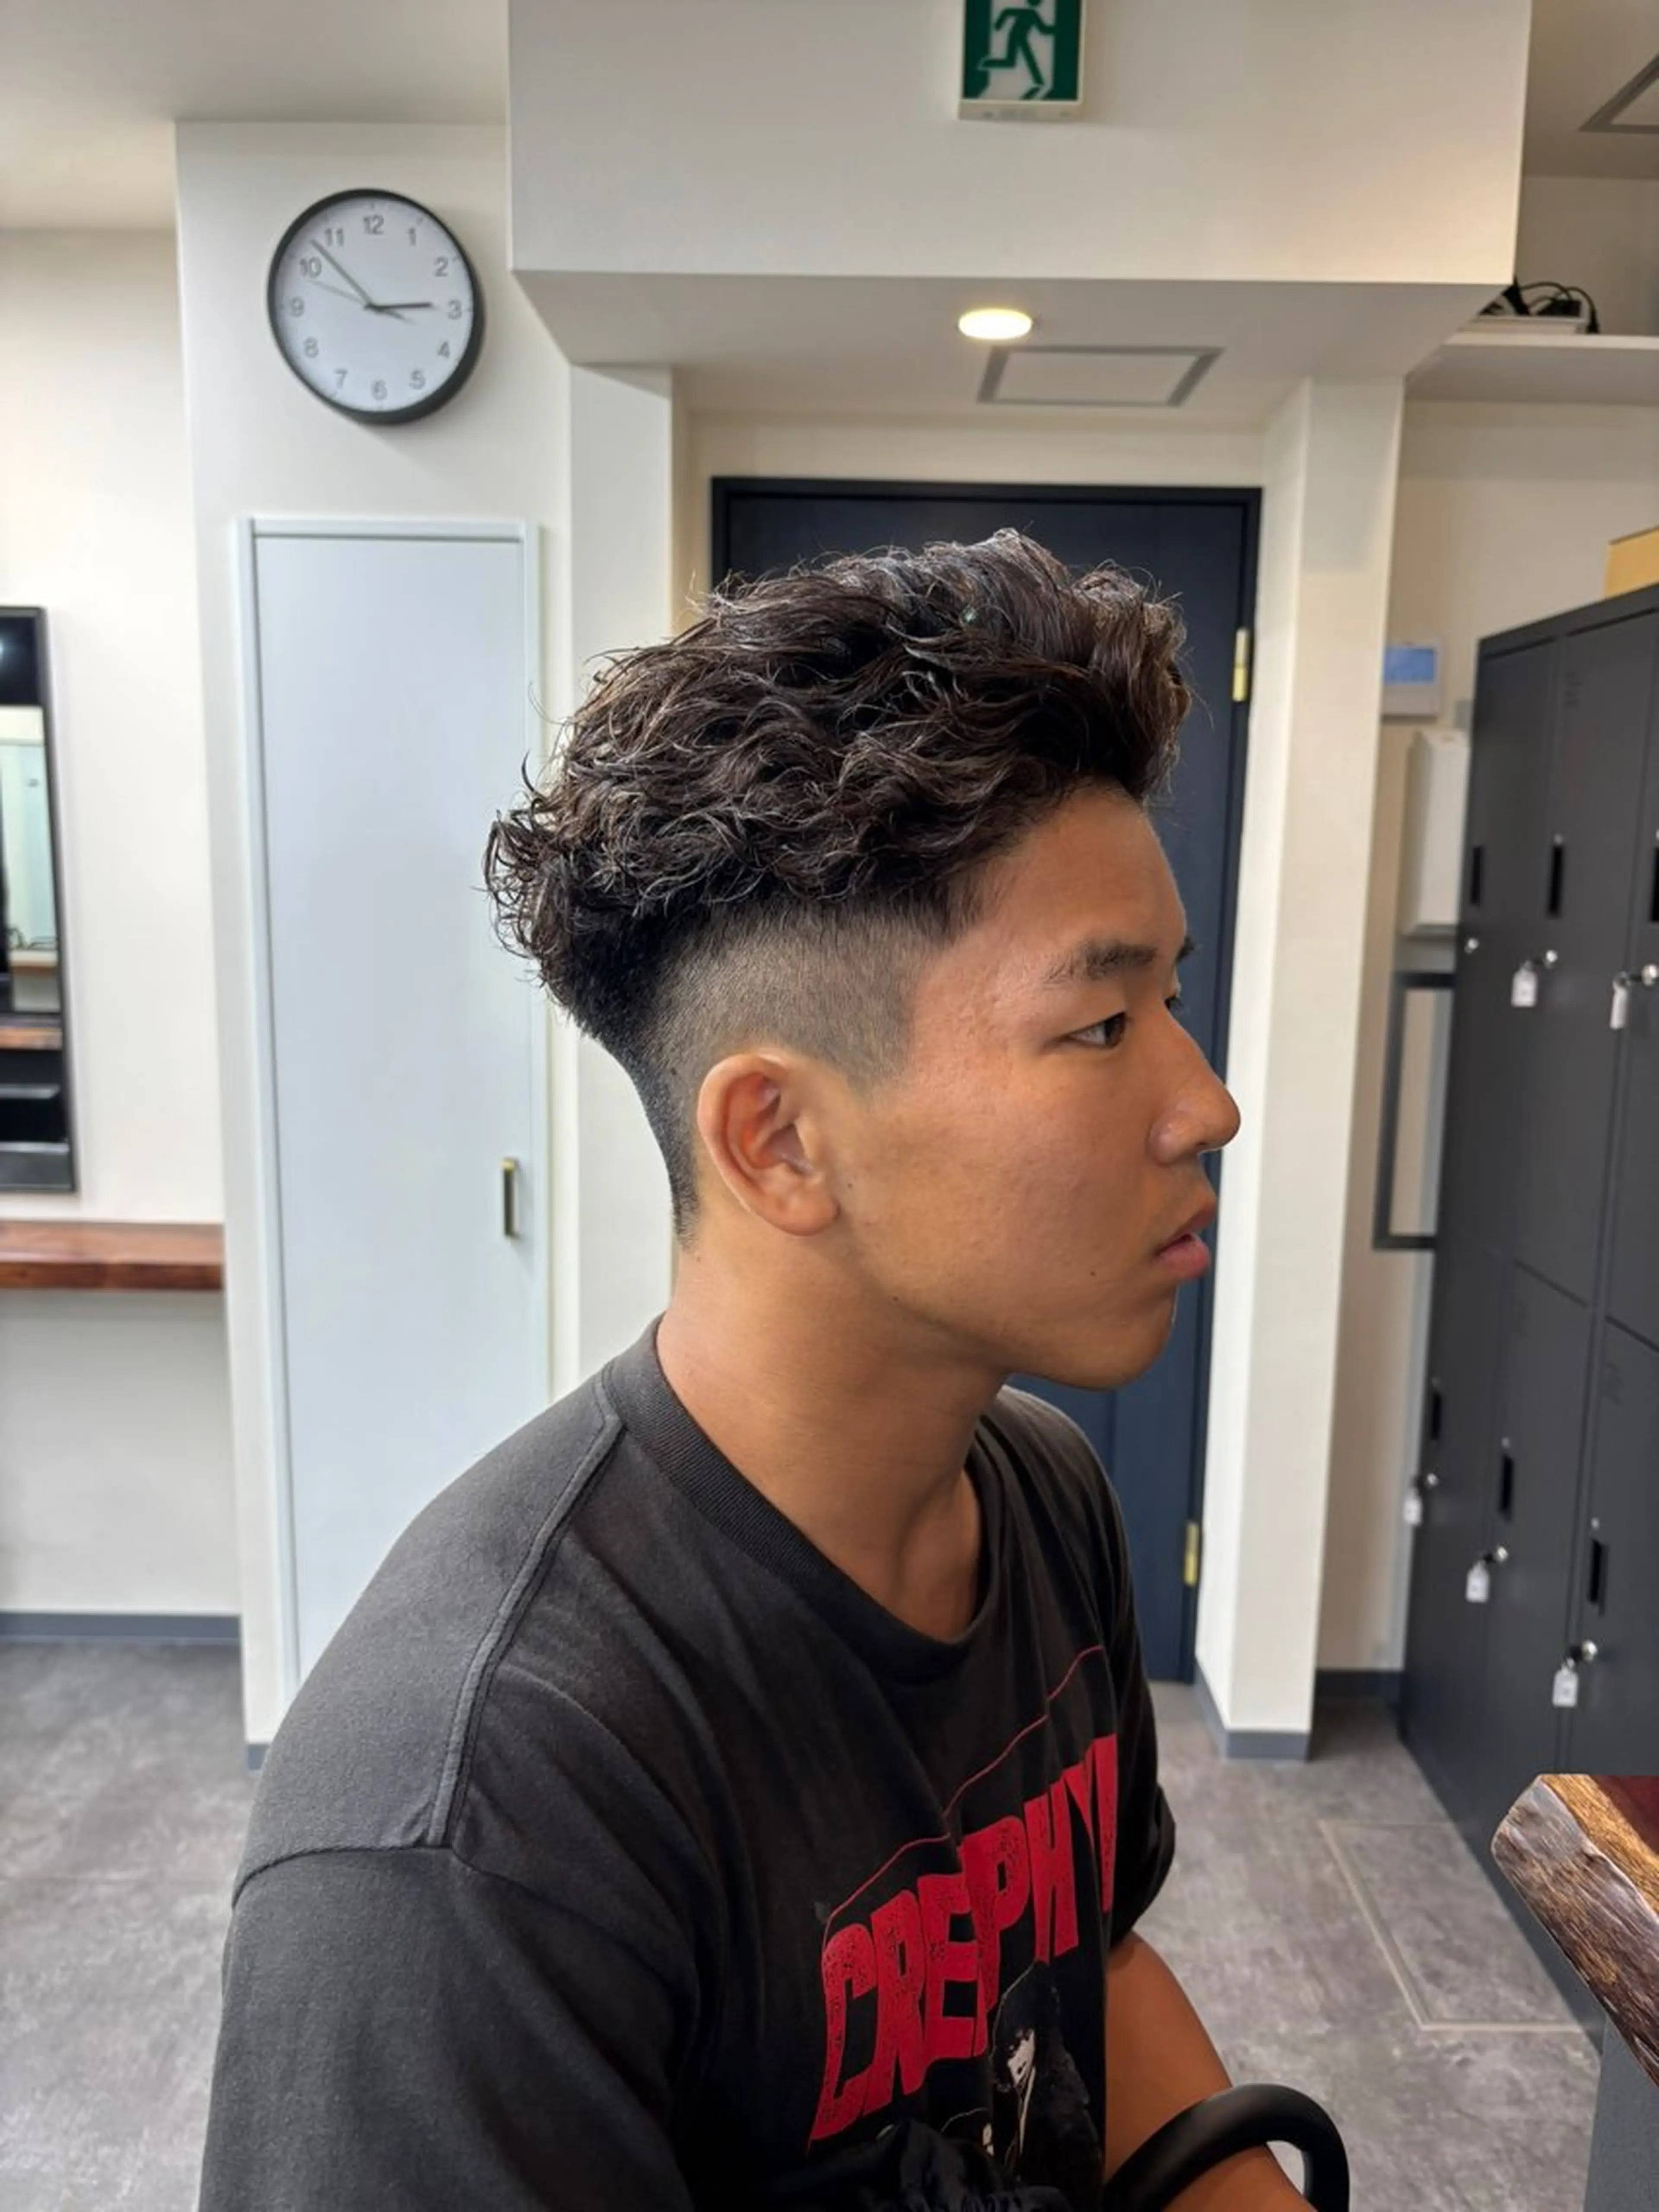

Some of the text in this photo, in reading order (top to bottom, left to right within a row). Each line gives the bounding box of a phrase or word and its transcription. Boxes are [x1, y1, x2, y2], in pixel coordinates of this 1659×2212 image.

[363, 215, 384, 235] 12
[324, 228, 344, 246] 11
[407, 228, 416, 246] 1
[299, 257, 322, 278] 10
[434, 257, 449, 277] 2
[290, 297, 304, 318] 9
[447, 299, 462, 320] 3
[304, 337, 319, 359] 8
[437, 342, 450, 358] 4
[334, 369, 349, 388] 7
[409, 370, 426, 389] 5
[372, 380, 388, 400] 6
